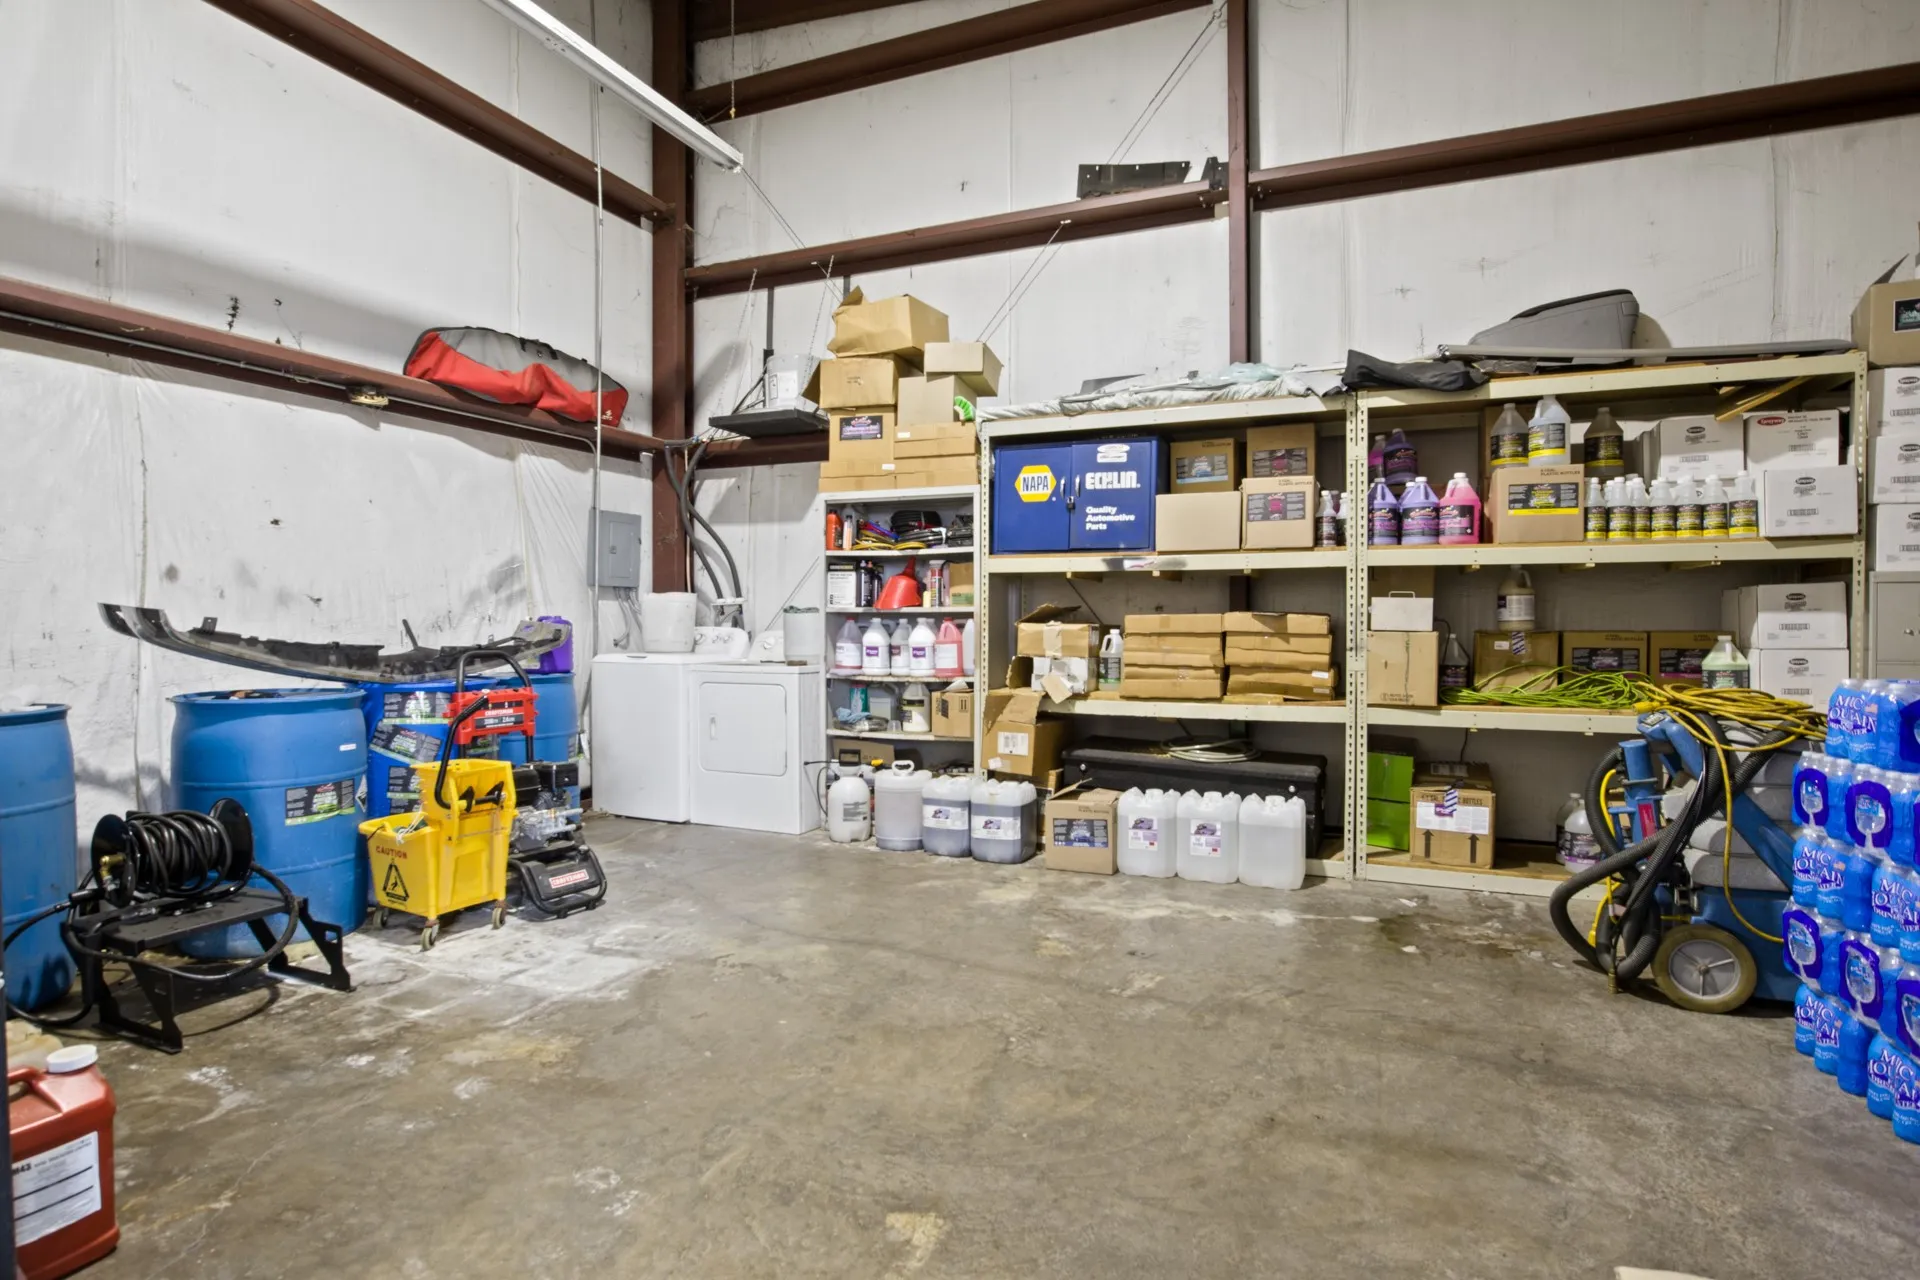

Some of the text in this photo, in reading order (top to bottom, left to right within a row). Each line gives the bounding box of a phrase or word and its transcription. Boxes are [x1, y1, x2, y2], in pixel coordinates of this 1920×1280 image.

[1022, 475, 1049, 492] NAPA
[1085, 471, 1138, 490] ECHLIN
[1085, 506, 1117, 515] Quality
[1085, 514, 1135, 522] Automotive
[375, 846, 408, 859] CAUTION
